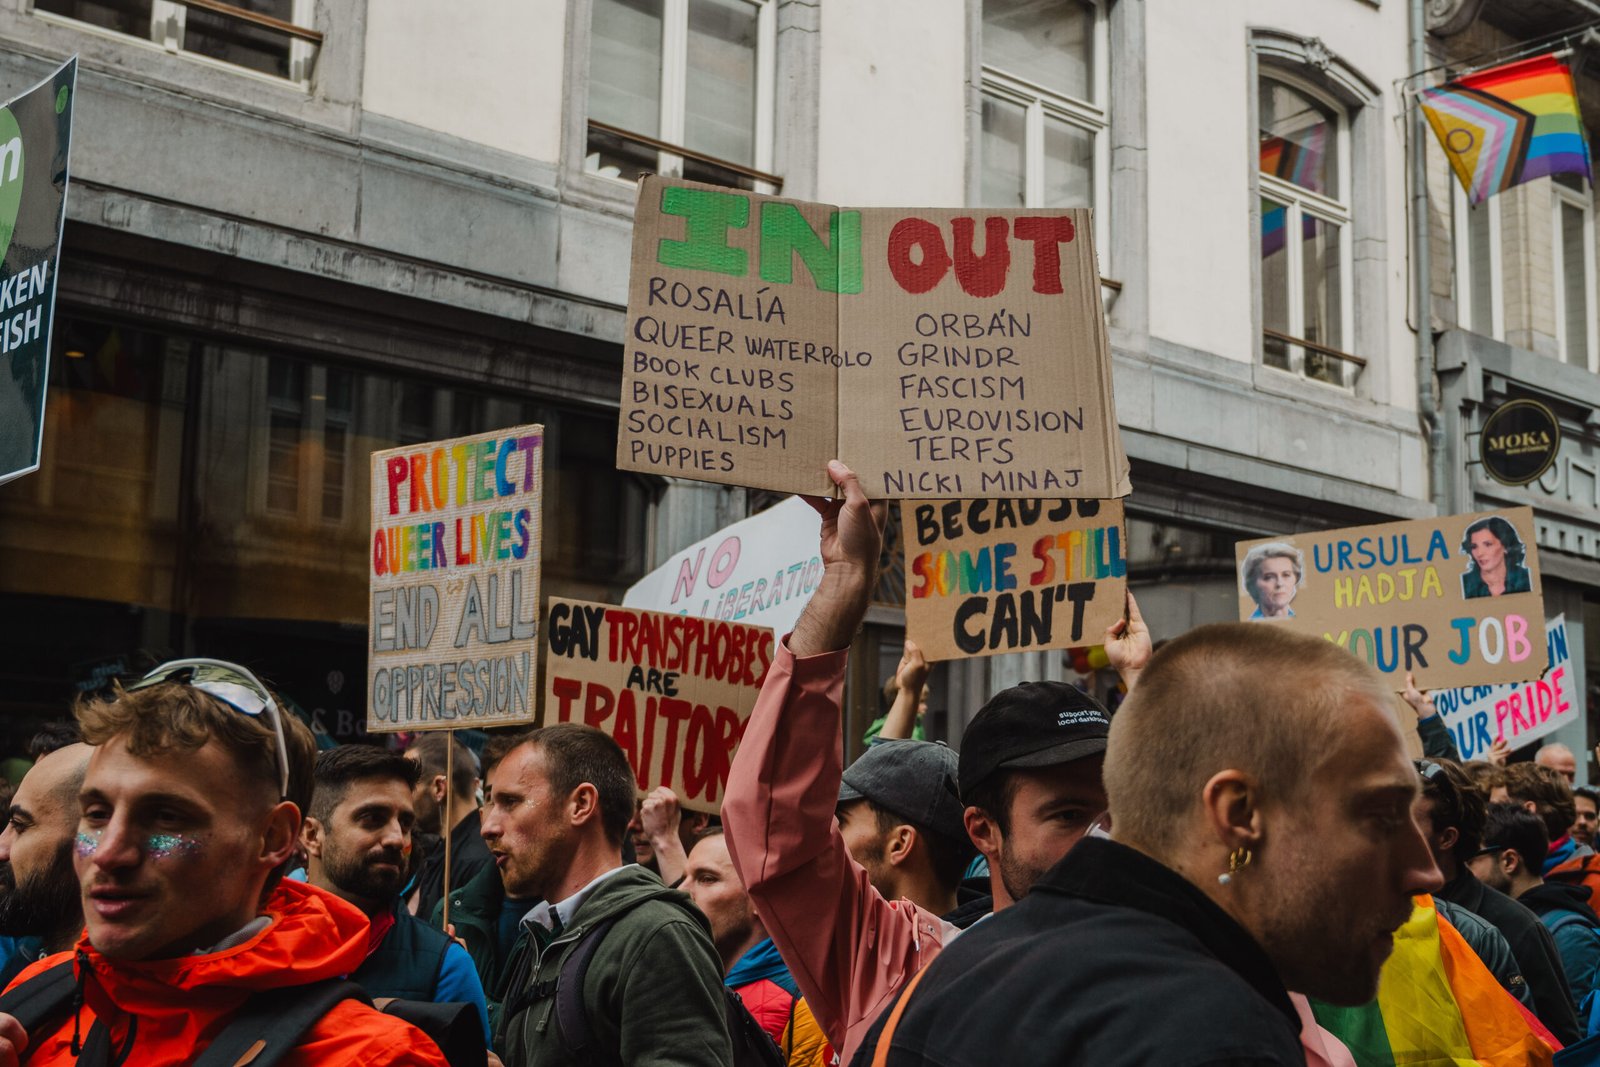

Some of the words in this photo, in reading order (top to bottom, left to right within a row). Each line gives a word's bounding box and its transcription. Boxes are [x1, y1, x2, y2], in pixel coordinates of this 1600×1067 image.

[656, 186, 862, 295] IN
[887, 216, 1075, 298] OUT
[0, 260, 48, 309] KEN
[648, 277, 785, 325] ROSALÍA
[634, 316, 734, 355] QUEER
[745, 337, 872, 367] WATERPOLO
[915, 309, 1031, 338] ORBÁN
[633, 351, 700, 380] BOOK
[710, 366, 794, 393] CLUBS
[898, 343, 1020, 366] GRINDR
[633, 381, 793, 420] BISEXUALS
[900, 375, 1024, 400] FASCISM
[628, 410, 787, 449] SOCIALISM
[900, 407, 1083, 433] EUROVISION
[1488, 430, 1551, 452] MOKA
[631, 440, 734, 472] PUPPIES
[909, 437, 1014, 463] TERFS
[386, 435, 544, 515] PROTECT
[884, 471, 962, 495] NICKI
[981, 469, 1082, 492] MINAJ
[373, 521, 447, 576] QUEER
[455, 508, 531, 566] LIVES
[912, 543, 1017, 598] SOME
[1030, 525, 1127, 586] STILL
[1313, 530, 1449, 573] URSULA
[670, 535, 741, 605] NO
[1334, 566, 1443, 609] HADJA
[373, 585, 439, 653] END
[454, 568, 536, 648] ALL
[954, 582, 1096, 654] CAN'T
[549, 603, 606, 661] GAY
[604, 610, 774, 689] TRANSPHOBES
[1448, 614, 1532, 665] JOB
[372, 652, 529, 723] OPPRESSION
[627, 666, 680, 697] ARE
[1434, 688, 1460, 717] OU
[1057, 717, 1078, 726] local
[1058, 710, 1089, 719] support
[1494, 667, 1569, 743] PRIDE
[553, 677, 752, 803] TAITOR
